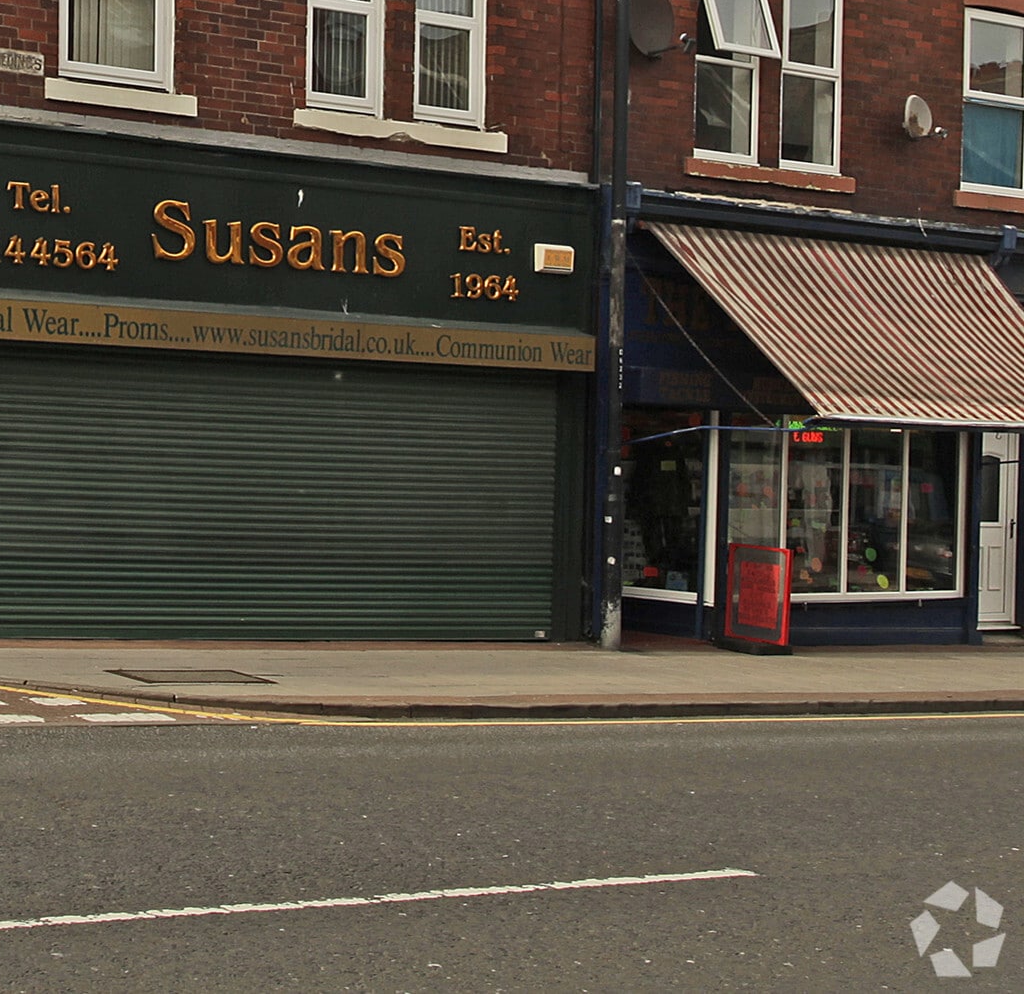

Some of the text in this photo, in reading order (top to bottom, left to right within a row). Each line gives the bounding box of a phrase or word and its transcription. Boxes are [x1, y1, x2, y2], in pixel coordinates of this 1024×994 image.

[6, 180, 72, 214] Tel.
[150, 199, 406, 278] Susans
[458, 225, 512, 255] Est.
[449, 272, 520, 302] 1964
[435, 334, 543, 363] Communion
[550, 340, 594, 366] Wear
